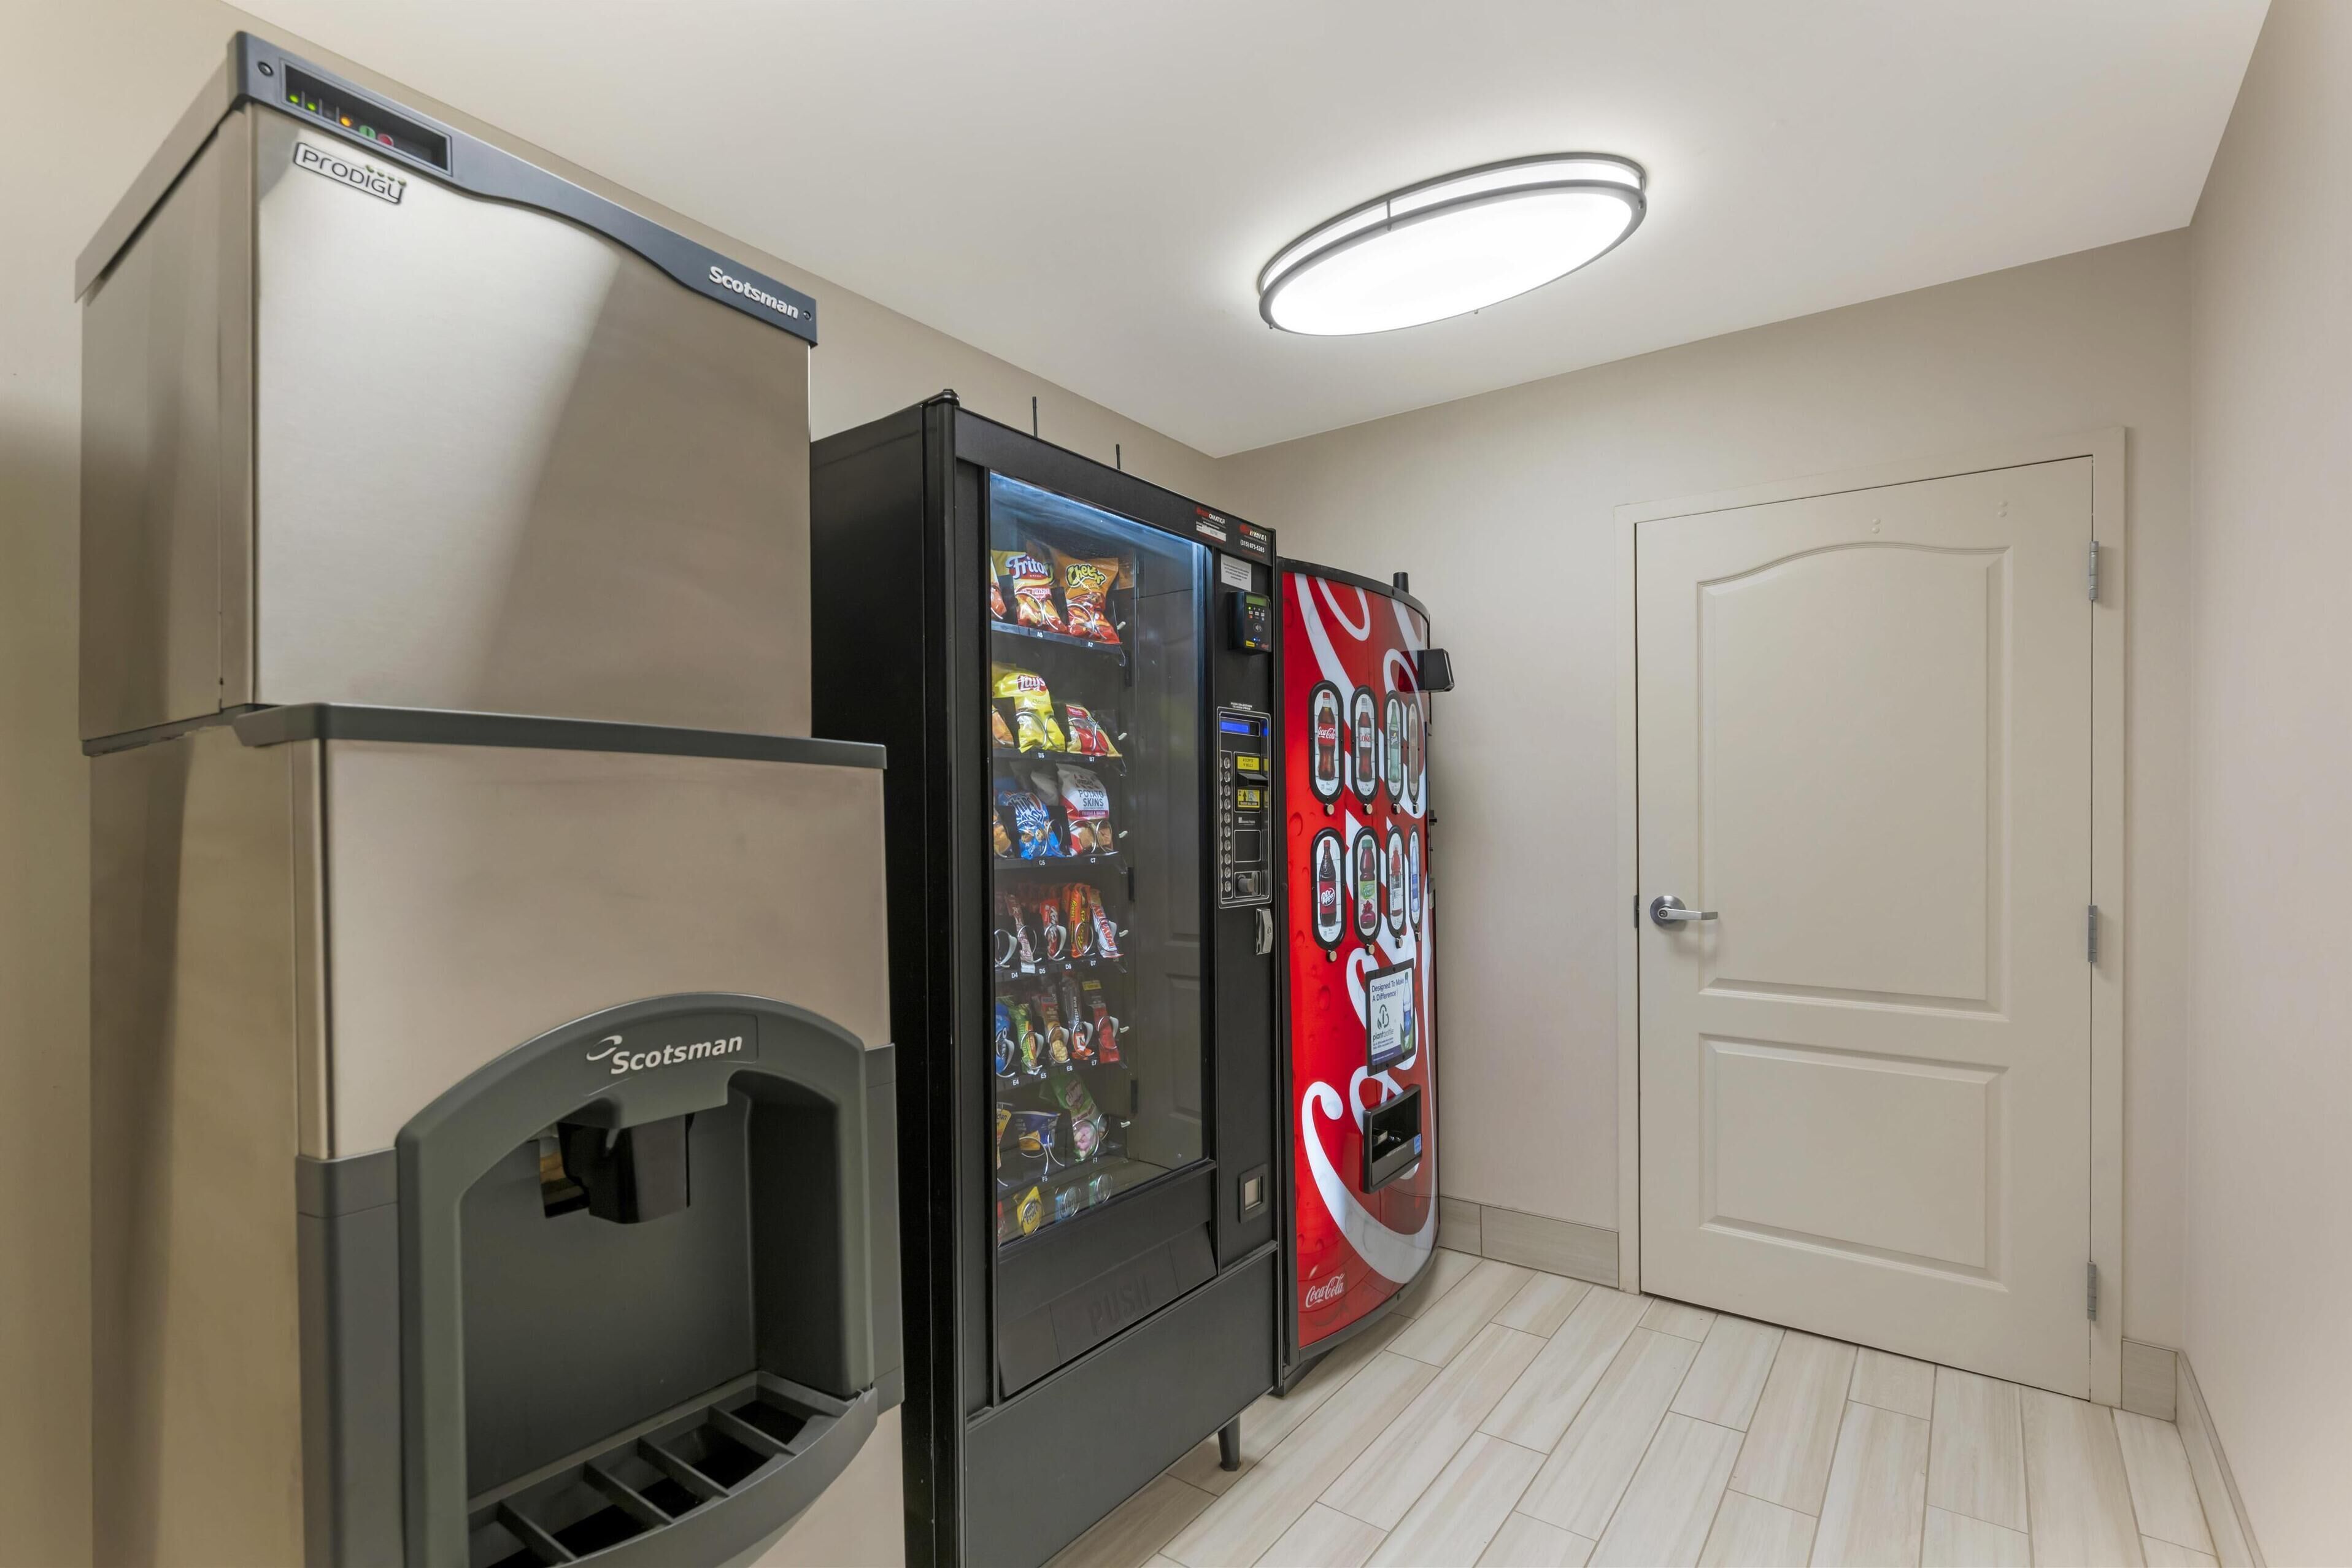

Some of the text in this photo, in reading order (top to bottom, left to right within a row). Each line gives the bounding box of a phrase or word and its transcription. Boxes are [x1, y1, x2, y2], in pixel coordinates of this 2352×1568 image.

[709, 266, 798, 319] Scotsman
[1317, 726, 1336, 739] Coca-Cola
[1078, 790, 1105, 798] POTATO
[1082, 797, 1104, 807] SKINS
[1372, 982, 1390, 992] Designed
[1376, 991, 1397, 1001] Difference
[611, 1036, 743, 1075] Scotsman
[1306, 1274, 1345, 1307] Coca-Cola
[1087, 1274, 1152, 1336] PUSH
